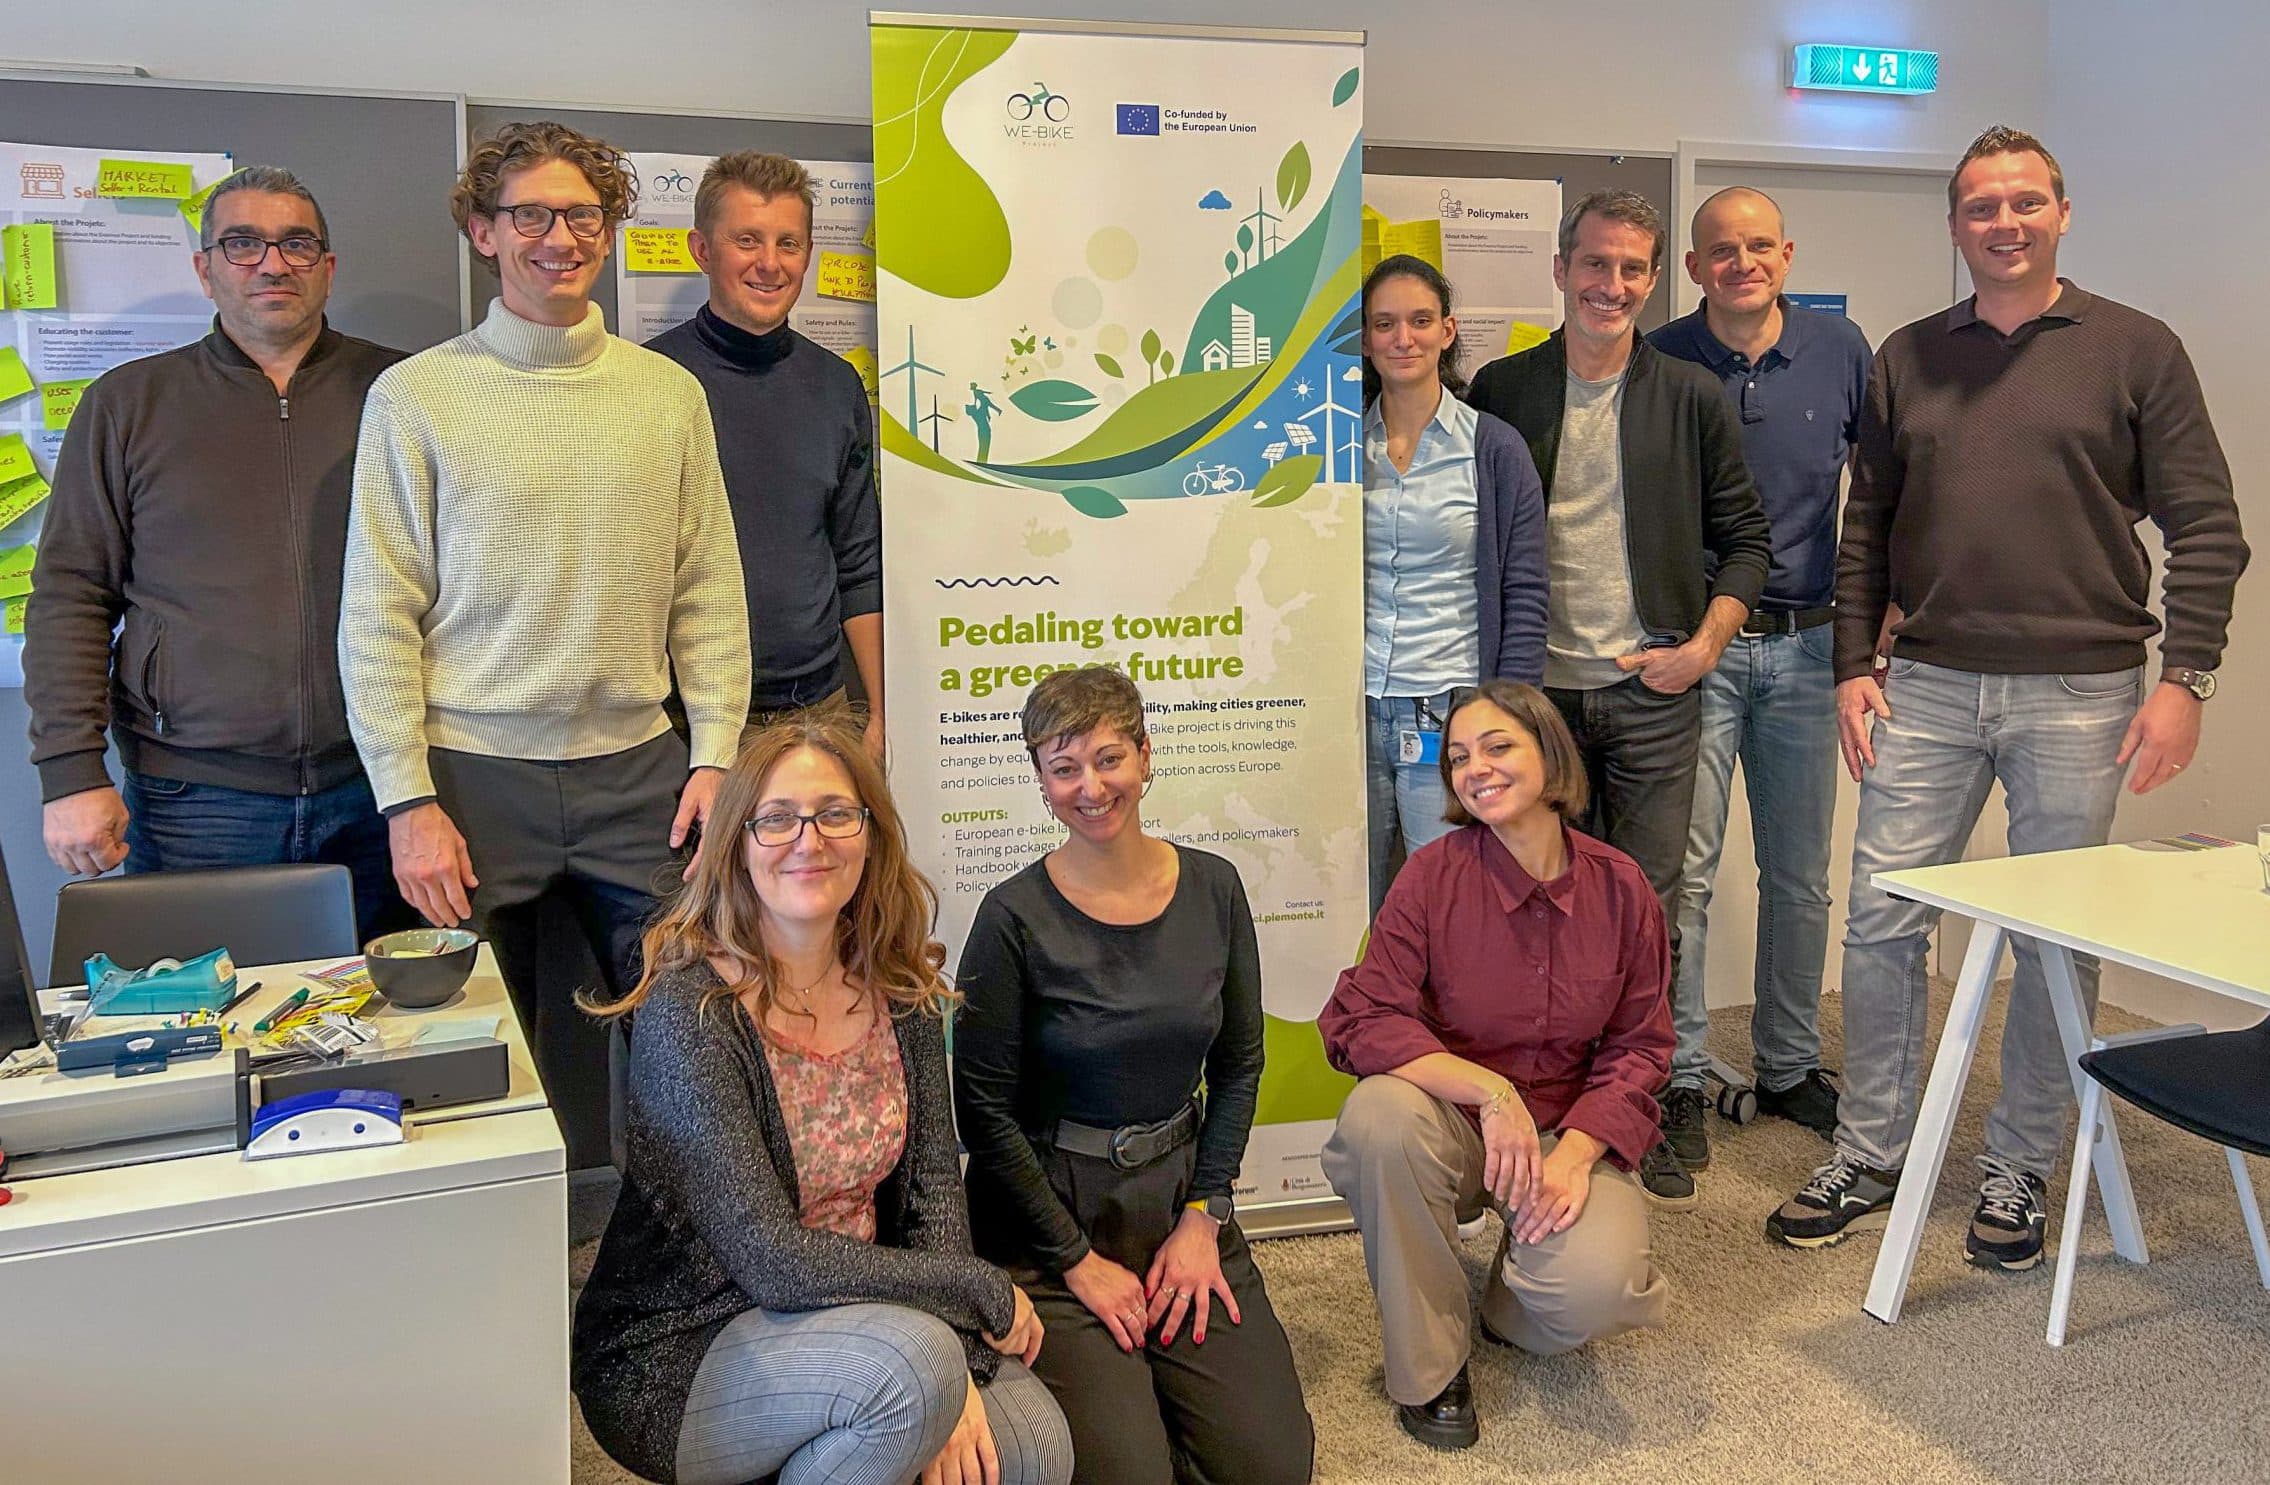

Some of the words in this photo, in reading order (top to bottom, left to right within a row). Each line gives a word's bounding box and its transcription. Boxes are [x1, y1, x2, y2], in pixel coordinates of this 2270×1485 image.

[1164, 110, 1213, 120] Co-funded
[1215, 111, 1228, 122] by
[1003, 124, 1075, 139] WE-BIKE
[1164, 122, 1180, 131] the
[1182, 122, 1228, 134] European
[1229, 123, 1257, 133] Union
[103, 169, 173, 183] MARKET
[138, 183, 177, 194] Rental
[829, 179, 872, 191] Current
[830, 196, 875, 207] potentia
[1467, 208, 1529, 220] Policymakers
[38, 327, 79, 336] Educating
[940, 611, 1104, 649] Pedaling
[1112, 606, 1243, 640] toward
[940, 668, 962, 691] a
[970, 661, 1121, 698] gree
[1127, 652, 1244, 682] future
[1143, 701, 1171, 716] ility,
[1173, 700, 1218, 713] making
[1219, 698, 1254, 710] cities
[1255, 697, 1307, 711] greener,
[940, 711, 987, 724] E-bikes
[989, 711, 1010, 721] are
[1177, 720, 1220, 736] project
[1222, 720, 1232, 731] is
[1234, 718, 1274, 732] driving
[1276, 717, 1297, 729] this
[940, 732, 1000, 746] healthier,
[1150, 743, 1174, 756] with
[1176, 743, 1196, 754] the
[1198, 741, 1230, 753] tools,
[1231, 739, 1297, 752] knowledge,
[940, 756, 986, 769] change
[989, 753, 1005, 767] by
[1198, 762, 1236, 775] across
[1238, 760, 1284, 775] Europe.
[940, 777, 965, 789] and
[967, 774, 1015, 790] policies
[1018, 774, 1031, 784] to
[941, 809, 1009, 824] OUTPUTS:
[955, 827, 1014, 842] European
[1016, 823, 1055, 837] e-bike
[1197, 829, 1219, 842] and
[1222, 826, 1300, 842] policymakers
[955, 846, 1002, 858] Training
[1004, 840, 1056, 857] package
[955, 860, 1020, 875] Handbook
[955, 880, 992, 893] Policy
[1285, 901, 1314, 909] Contact
